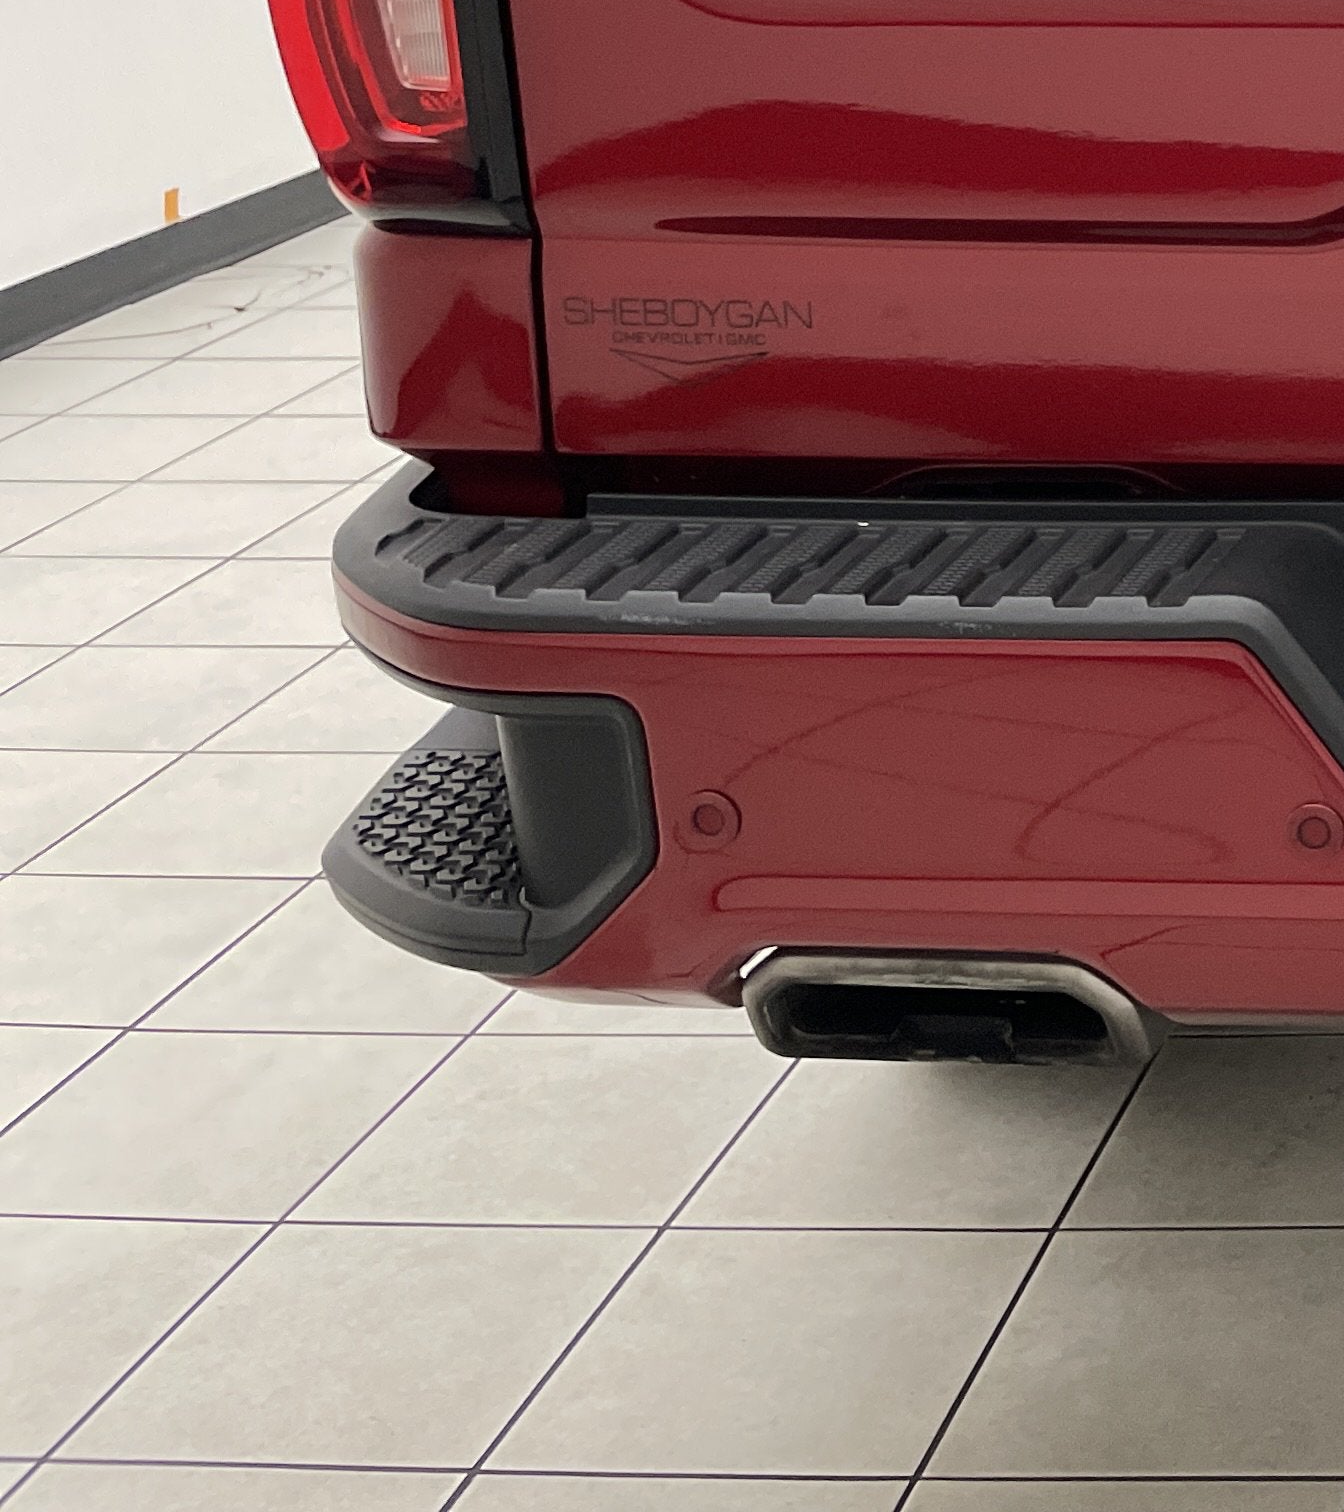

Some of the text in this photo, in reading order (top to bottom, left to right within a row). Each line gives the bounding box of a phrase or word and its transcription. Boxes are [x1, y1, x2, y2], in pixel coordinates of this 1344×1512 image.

[563, 296, 813, 329] SHEBOYGAN
[612, 331, 767, 346] CHEVROLET GMC
